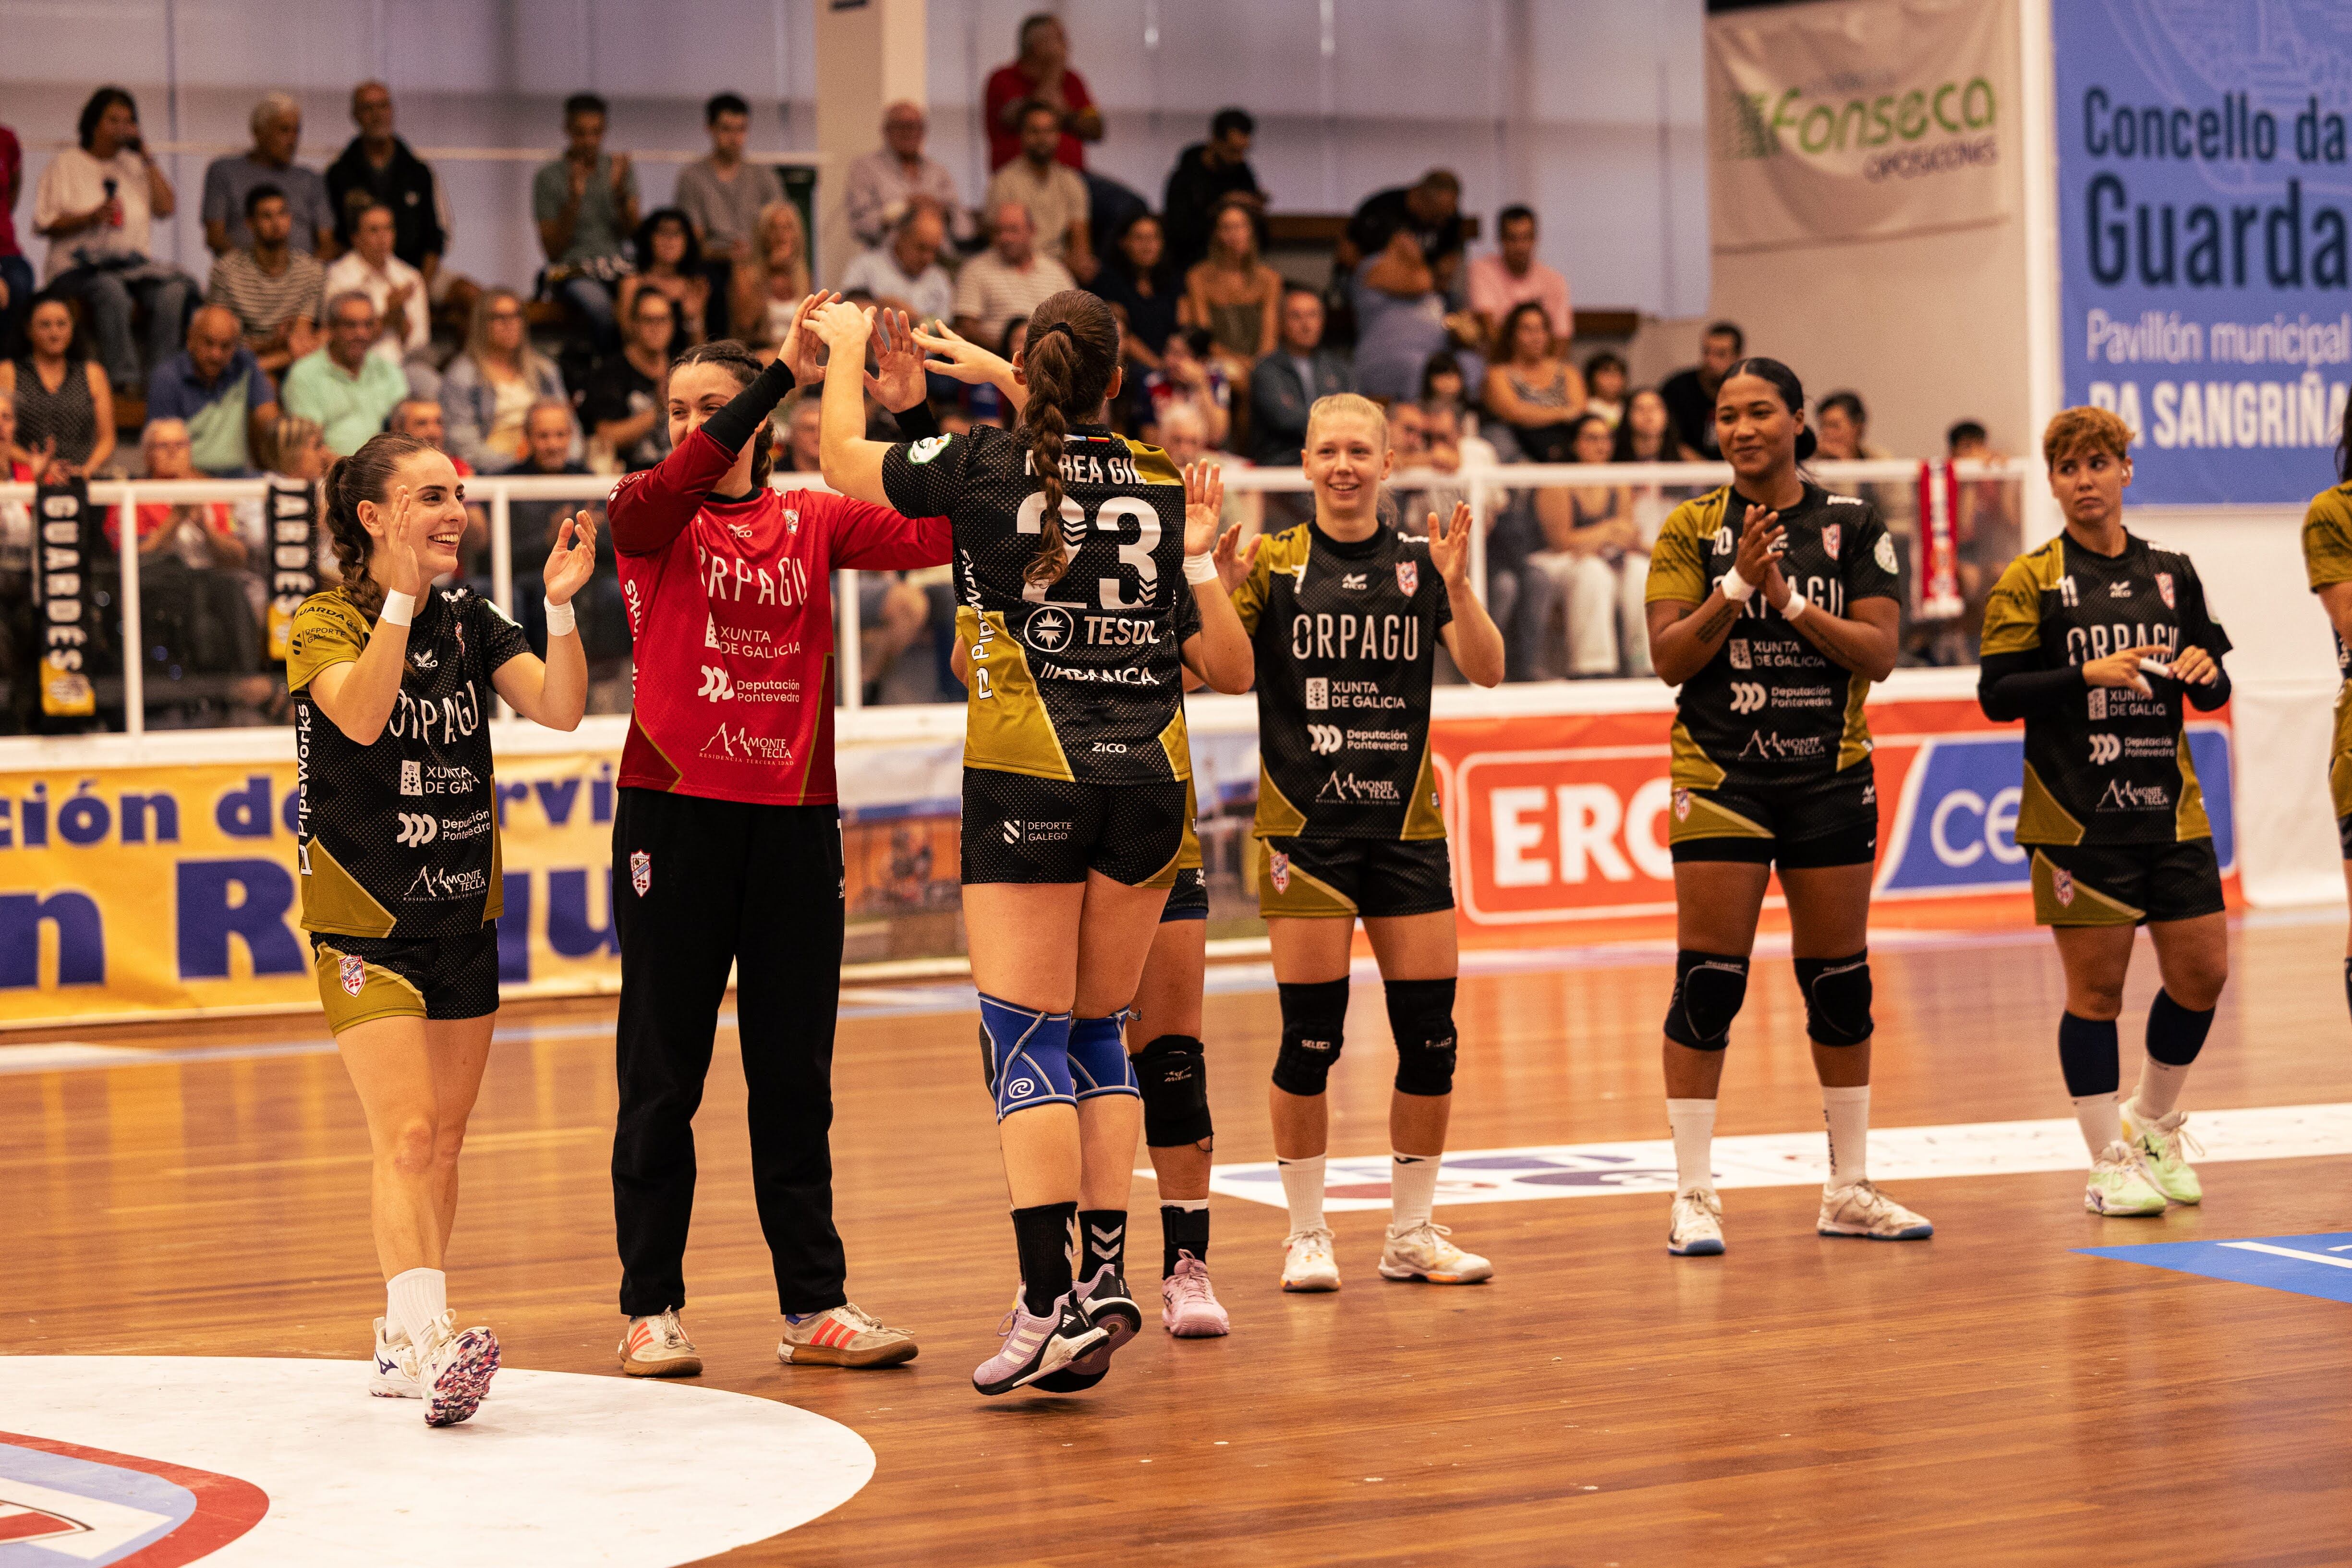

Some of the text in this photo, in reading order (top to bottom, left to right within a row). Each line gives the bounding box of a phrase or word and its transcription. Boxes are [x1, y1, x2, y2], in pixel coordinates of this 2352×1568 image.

[2084, 86, 2347, 163] Concello da
[2086, 171, 2349, 288] Guarda
[2087, 308, 2352, 368] Pavillón municipal
[1025, 450, 1147, 485] NREA GIL
[1017, 491, 1162, 610] 23
[2055, 575, 2079, 607] 11
[720, 626, 771, 644] XUNTA
[1293, 613, 1419, 661] ORPAGU
[720, 641, 800, 659] DE GALICIA
[1754, 641, 1801, 654] XUNTA
[1755, 654, 1826, 669] DE GALICIA
[737, 679, 800, 693] Deputación
[1332, 681, 1379, 694] XUNTA
[738, 692, 800, 703] Pontevedra
[1332, 695, 1406, 709] DE GALICIA
[1347, 729, 1408, 741] Deputación
[747, 737, 787, 749] MONTE
[1091, 742, 1127, 754] ZICO
[1347, 740, 1408, 751] Pontevedra
[699, 752, 742, 763] RESIDENCIA
[761, 748, 792, 759] TECLA
[298, 704, 312, 838] PipeWorks
[426, 766, 472, 778] XUNTA
[425, 781, 445, 794] DE
[1356, 780, 1394, 791] MONTE
[1370, 789, 1401, 800] TECLA
[1028, 822, 1072, 830] DEPORTE
[1029, 832, 1068, 841] GALEGO
[446, 869, 482, 885] MONTE
[460, 877, 486, 892] TECLA
